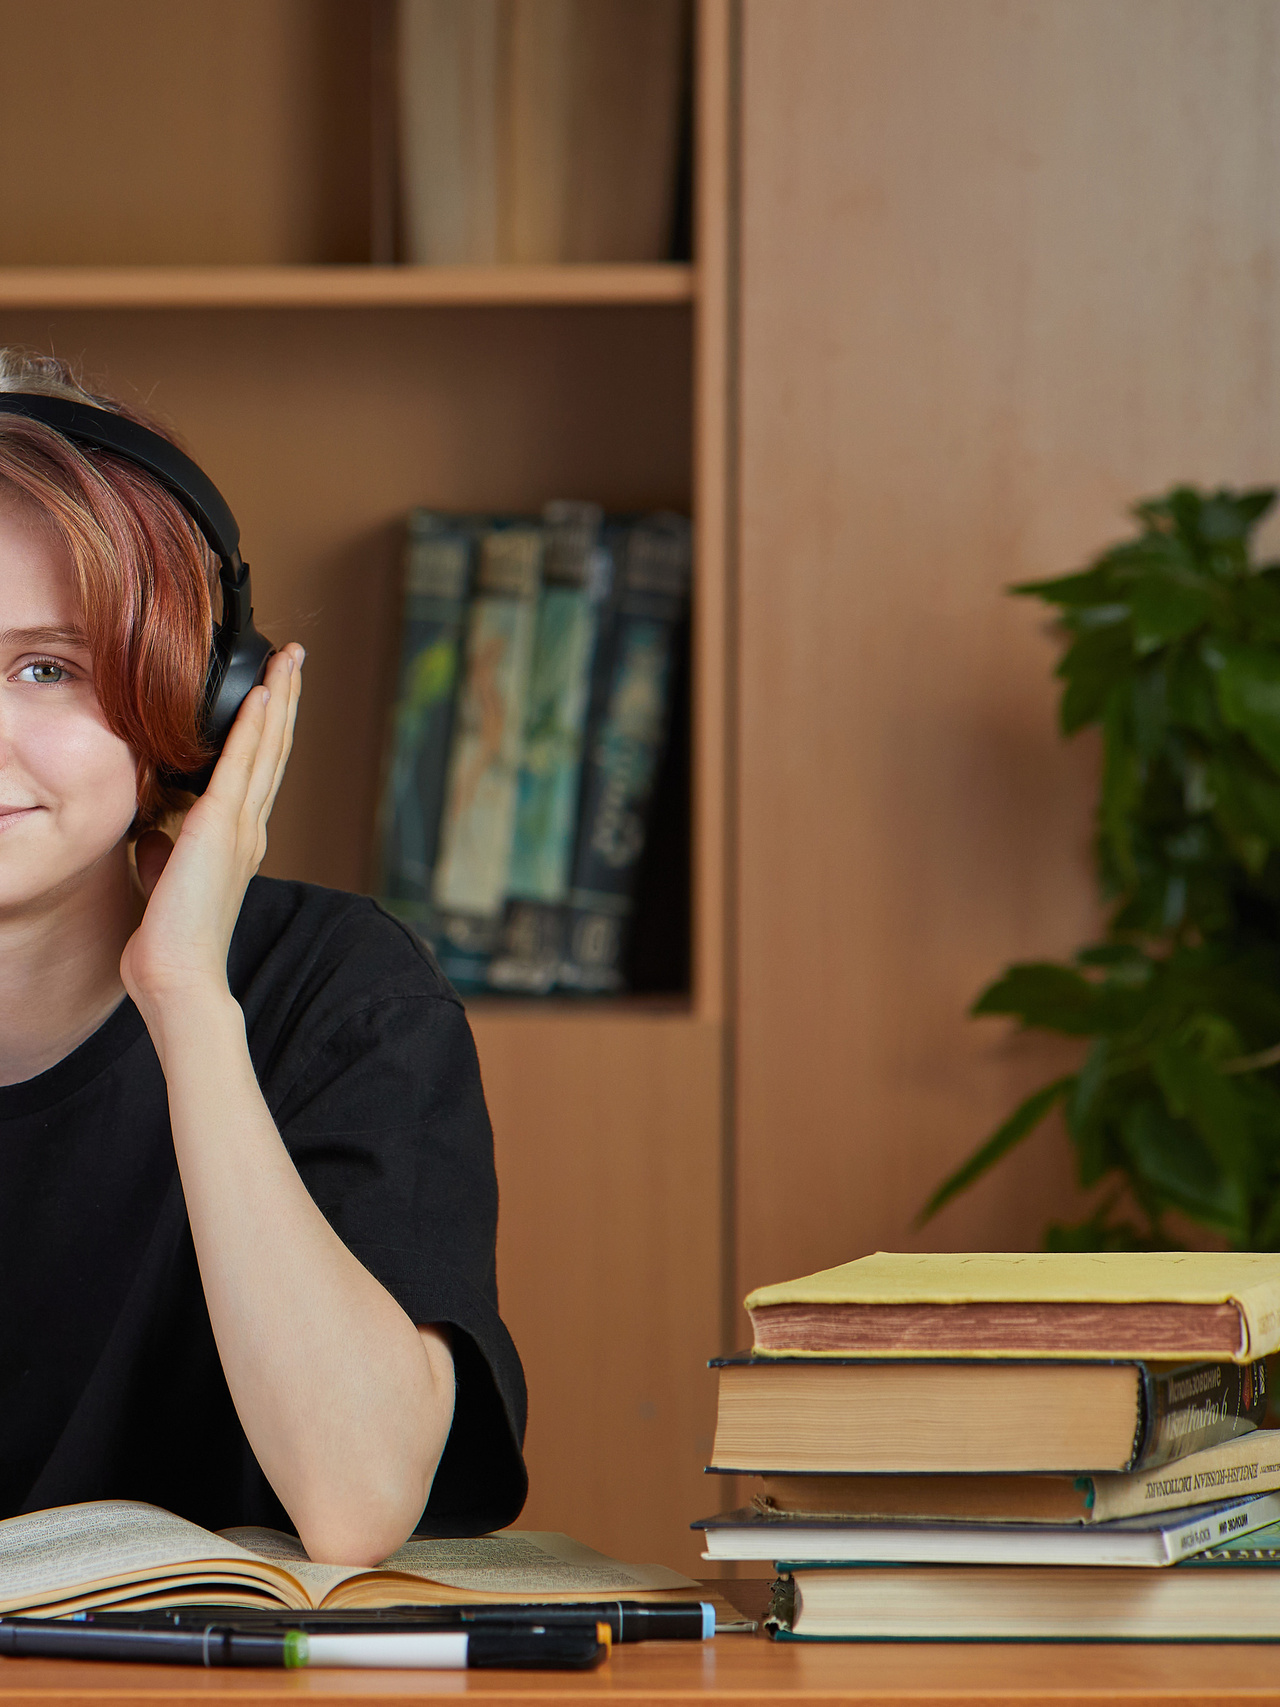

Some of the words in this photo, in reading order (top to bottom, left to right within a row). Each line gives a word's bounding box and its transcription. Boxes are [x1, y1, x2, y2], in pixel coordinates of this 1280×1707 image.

[1167, 1366, 1221, 1405] Использование
[1221, 1387, 1229, 1421] 6
[1145, 1476, 1192, 1499] DICTIONARY
[1194, 1463, 1259, 1490] ENGLISH-RUSSIAN
